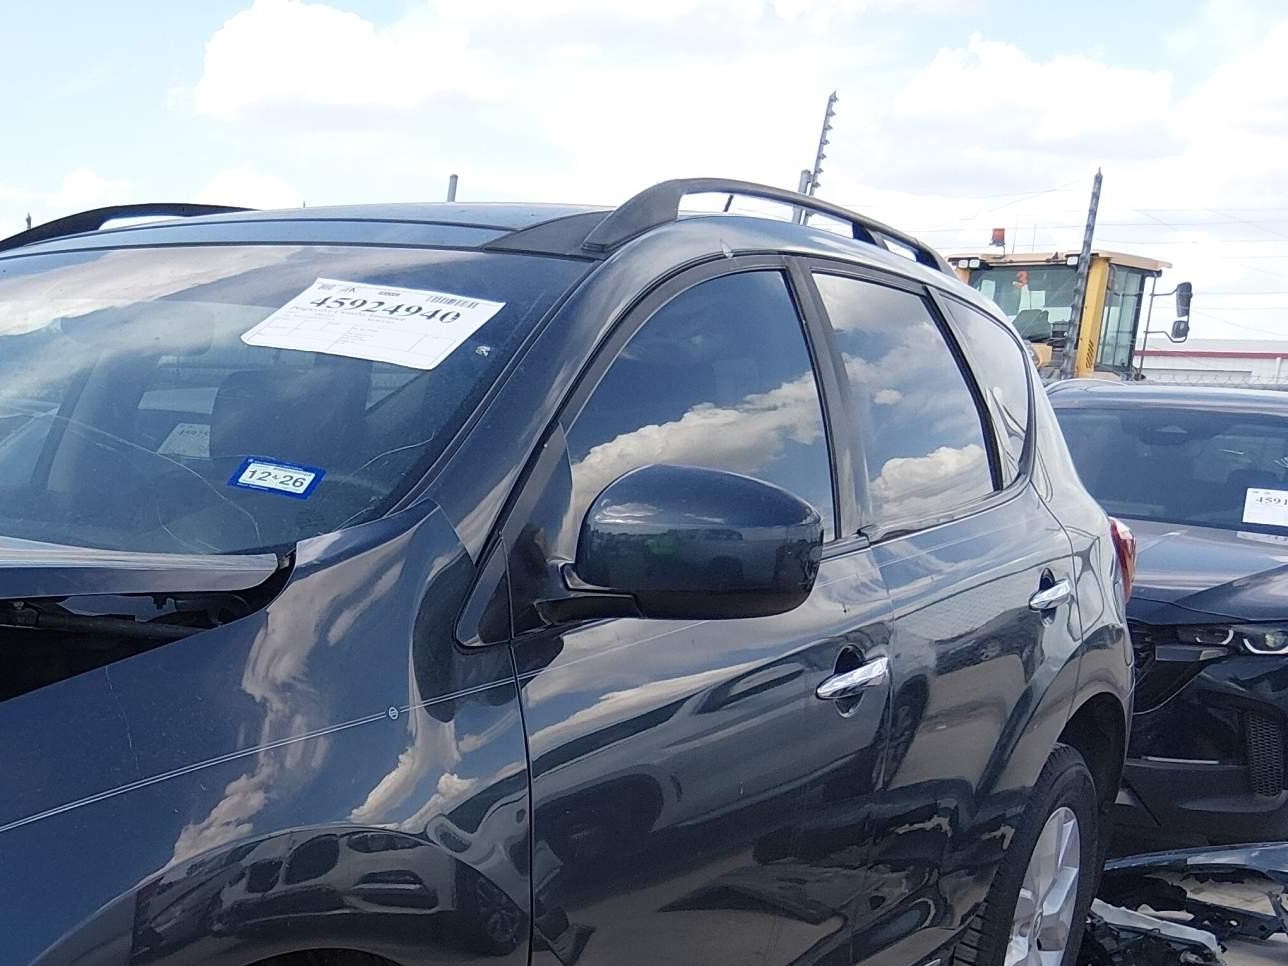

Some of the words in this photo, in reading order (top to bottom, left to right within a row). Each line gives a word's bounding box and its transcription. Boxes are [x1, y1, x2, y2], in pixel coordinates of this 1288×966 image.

[310, 295, 462, 324] 45924940
[248, 469, 272, 482] 12
[279, 474, 307, 488] 26
